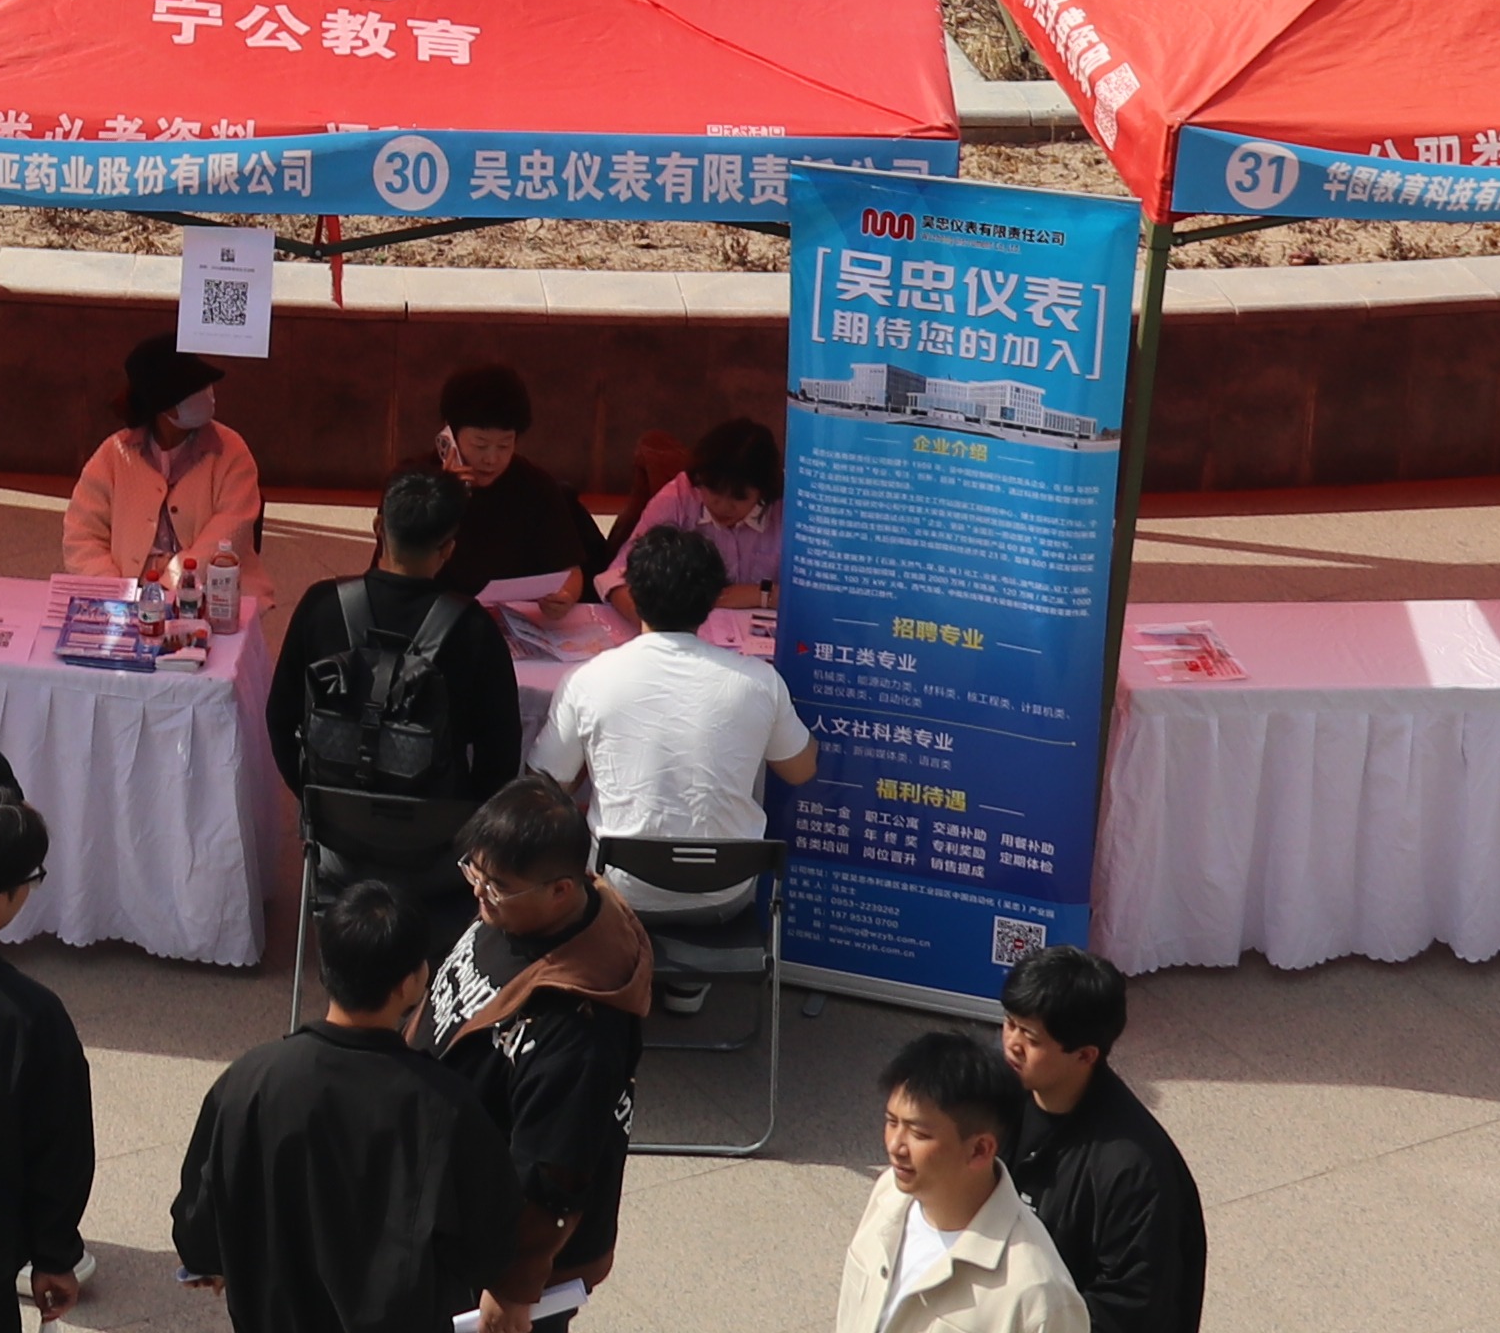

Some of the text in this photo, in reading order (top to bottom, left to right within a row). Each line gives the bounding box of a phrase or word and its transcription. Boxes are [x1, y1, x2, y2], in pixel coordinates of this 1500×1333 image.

[384, 151, 438, 196] 30
[1235, 153, 1286, 195] 31
[921, 215, 1065, 246] 吴忠仪表有限责任公司
[836, 248, 1084, 332] 吴忠仪表
[831, 309, 1081, 376] 期待您的加入
[912, 435, 988, 461] 企业介绍
[892, 616, 984, 650] 招聘专业
[813, 642, 917, 673] 理工类专业
[811, 714, 954, 752] 人文社科类专业
[875, 777, 967, 812] 福利待遇
[796, 800, 1055, 856] 五险一金 职工公寓 交通补助 用餐补助
[796, 818, 850, 837] 绩效奖金
[932, 840, 986, 860] 专利奖励
[999, 851, 1054, 874] 定期体检
[795, 836, 985, 878] 各类培训 岗位晋升 销售提成
